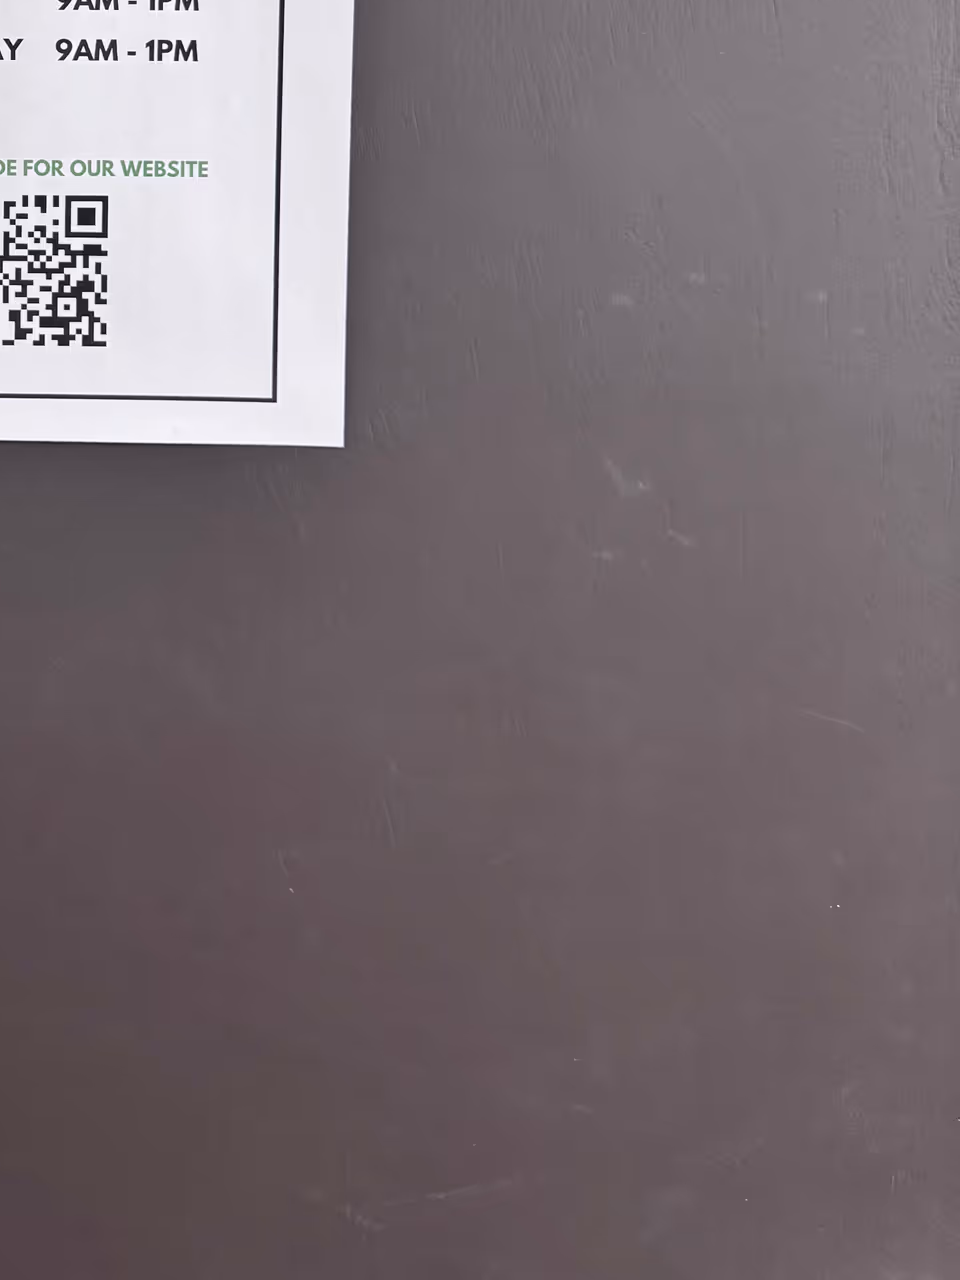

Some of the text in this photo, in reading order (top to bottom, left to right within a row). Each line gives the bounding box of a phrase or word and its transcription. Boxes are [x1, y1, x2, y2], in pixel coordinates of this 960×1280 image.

[56, 39, 118, 61] 9AM
[146, 40, 198, 61] 1PM
[24, 159, 65, 176] FOR
[70, 160, 115, 176] OUR
[120, 160, 208, 177] WEBSITE
